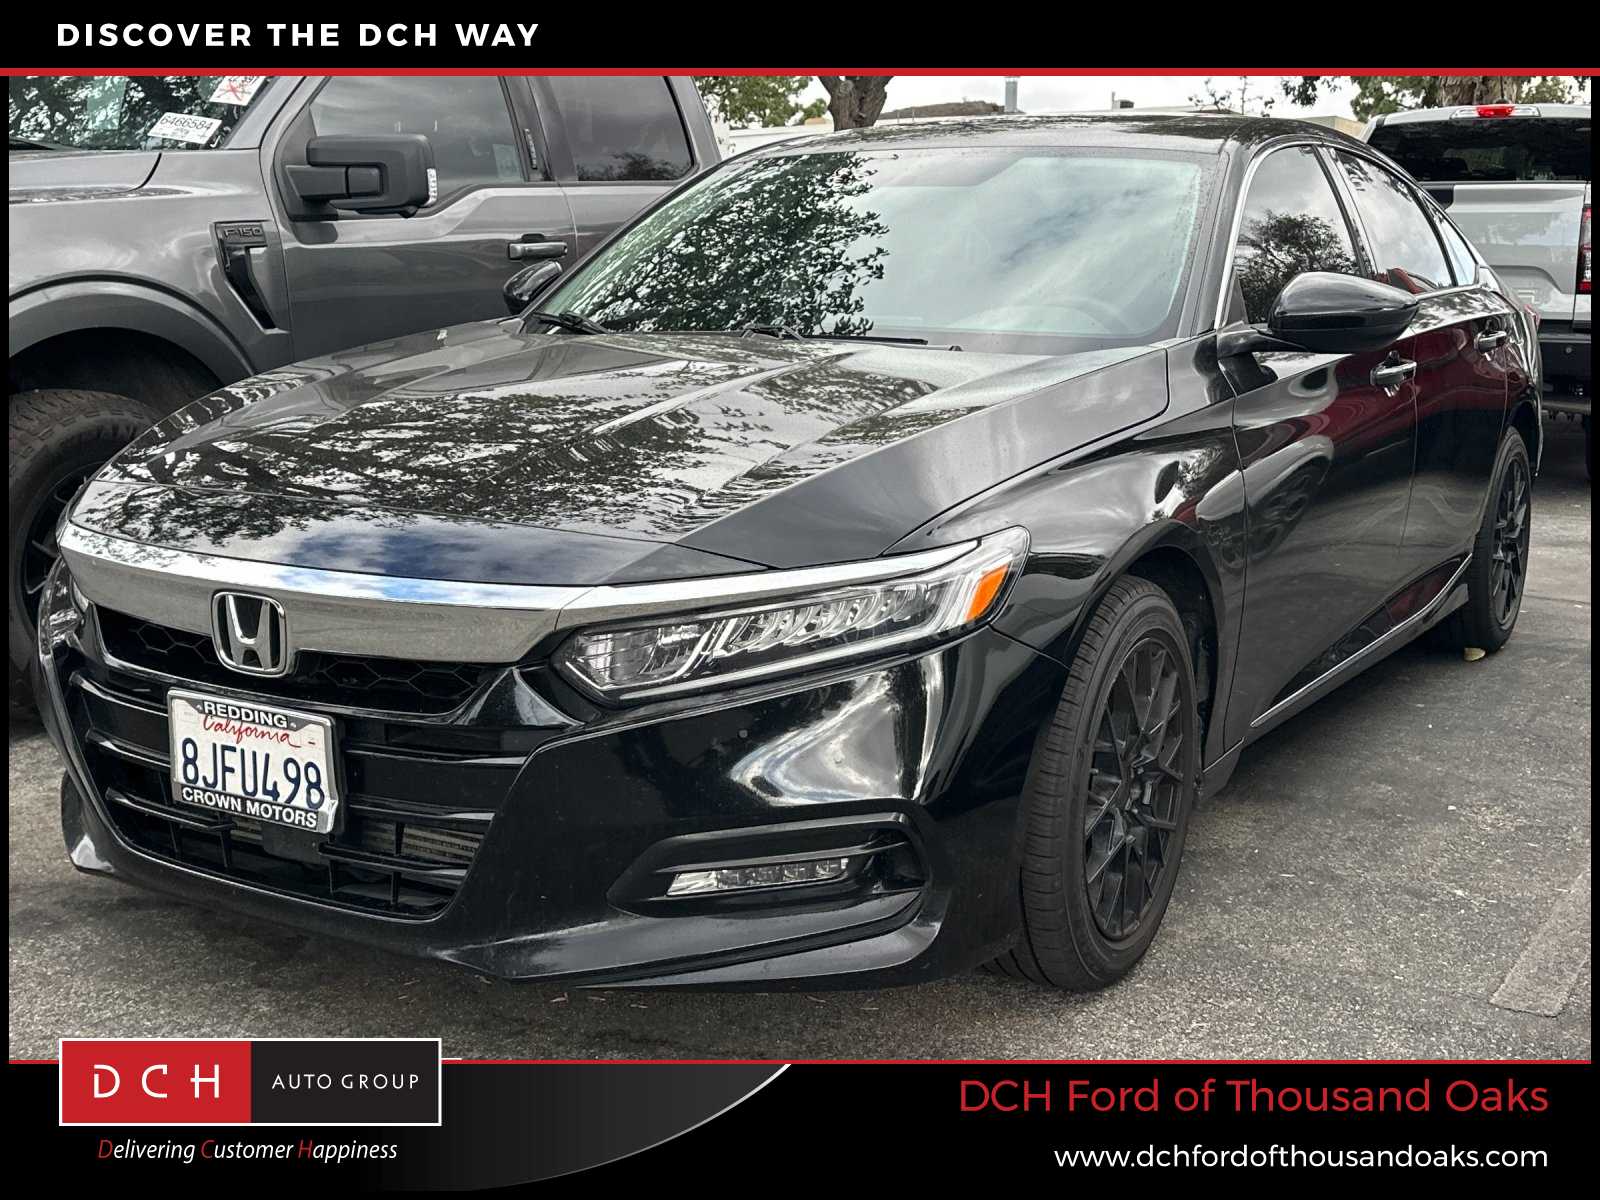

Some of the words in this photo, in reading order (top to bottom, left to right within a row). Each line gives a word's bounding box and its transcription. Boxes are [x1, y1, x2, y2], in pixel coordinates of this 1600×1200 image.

[203, 700, 288, 729] REDDING
[181, 737, 325, 810] 8JFU498
[182, 786, 242, 812] CROWN
[246, 801, 318, 829] MOTORS
